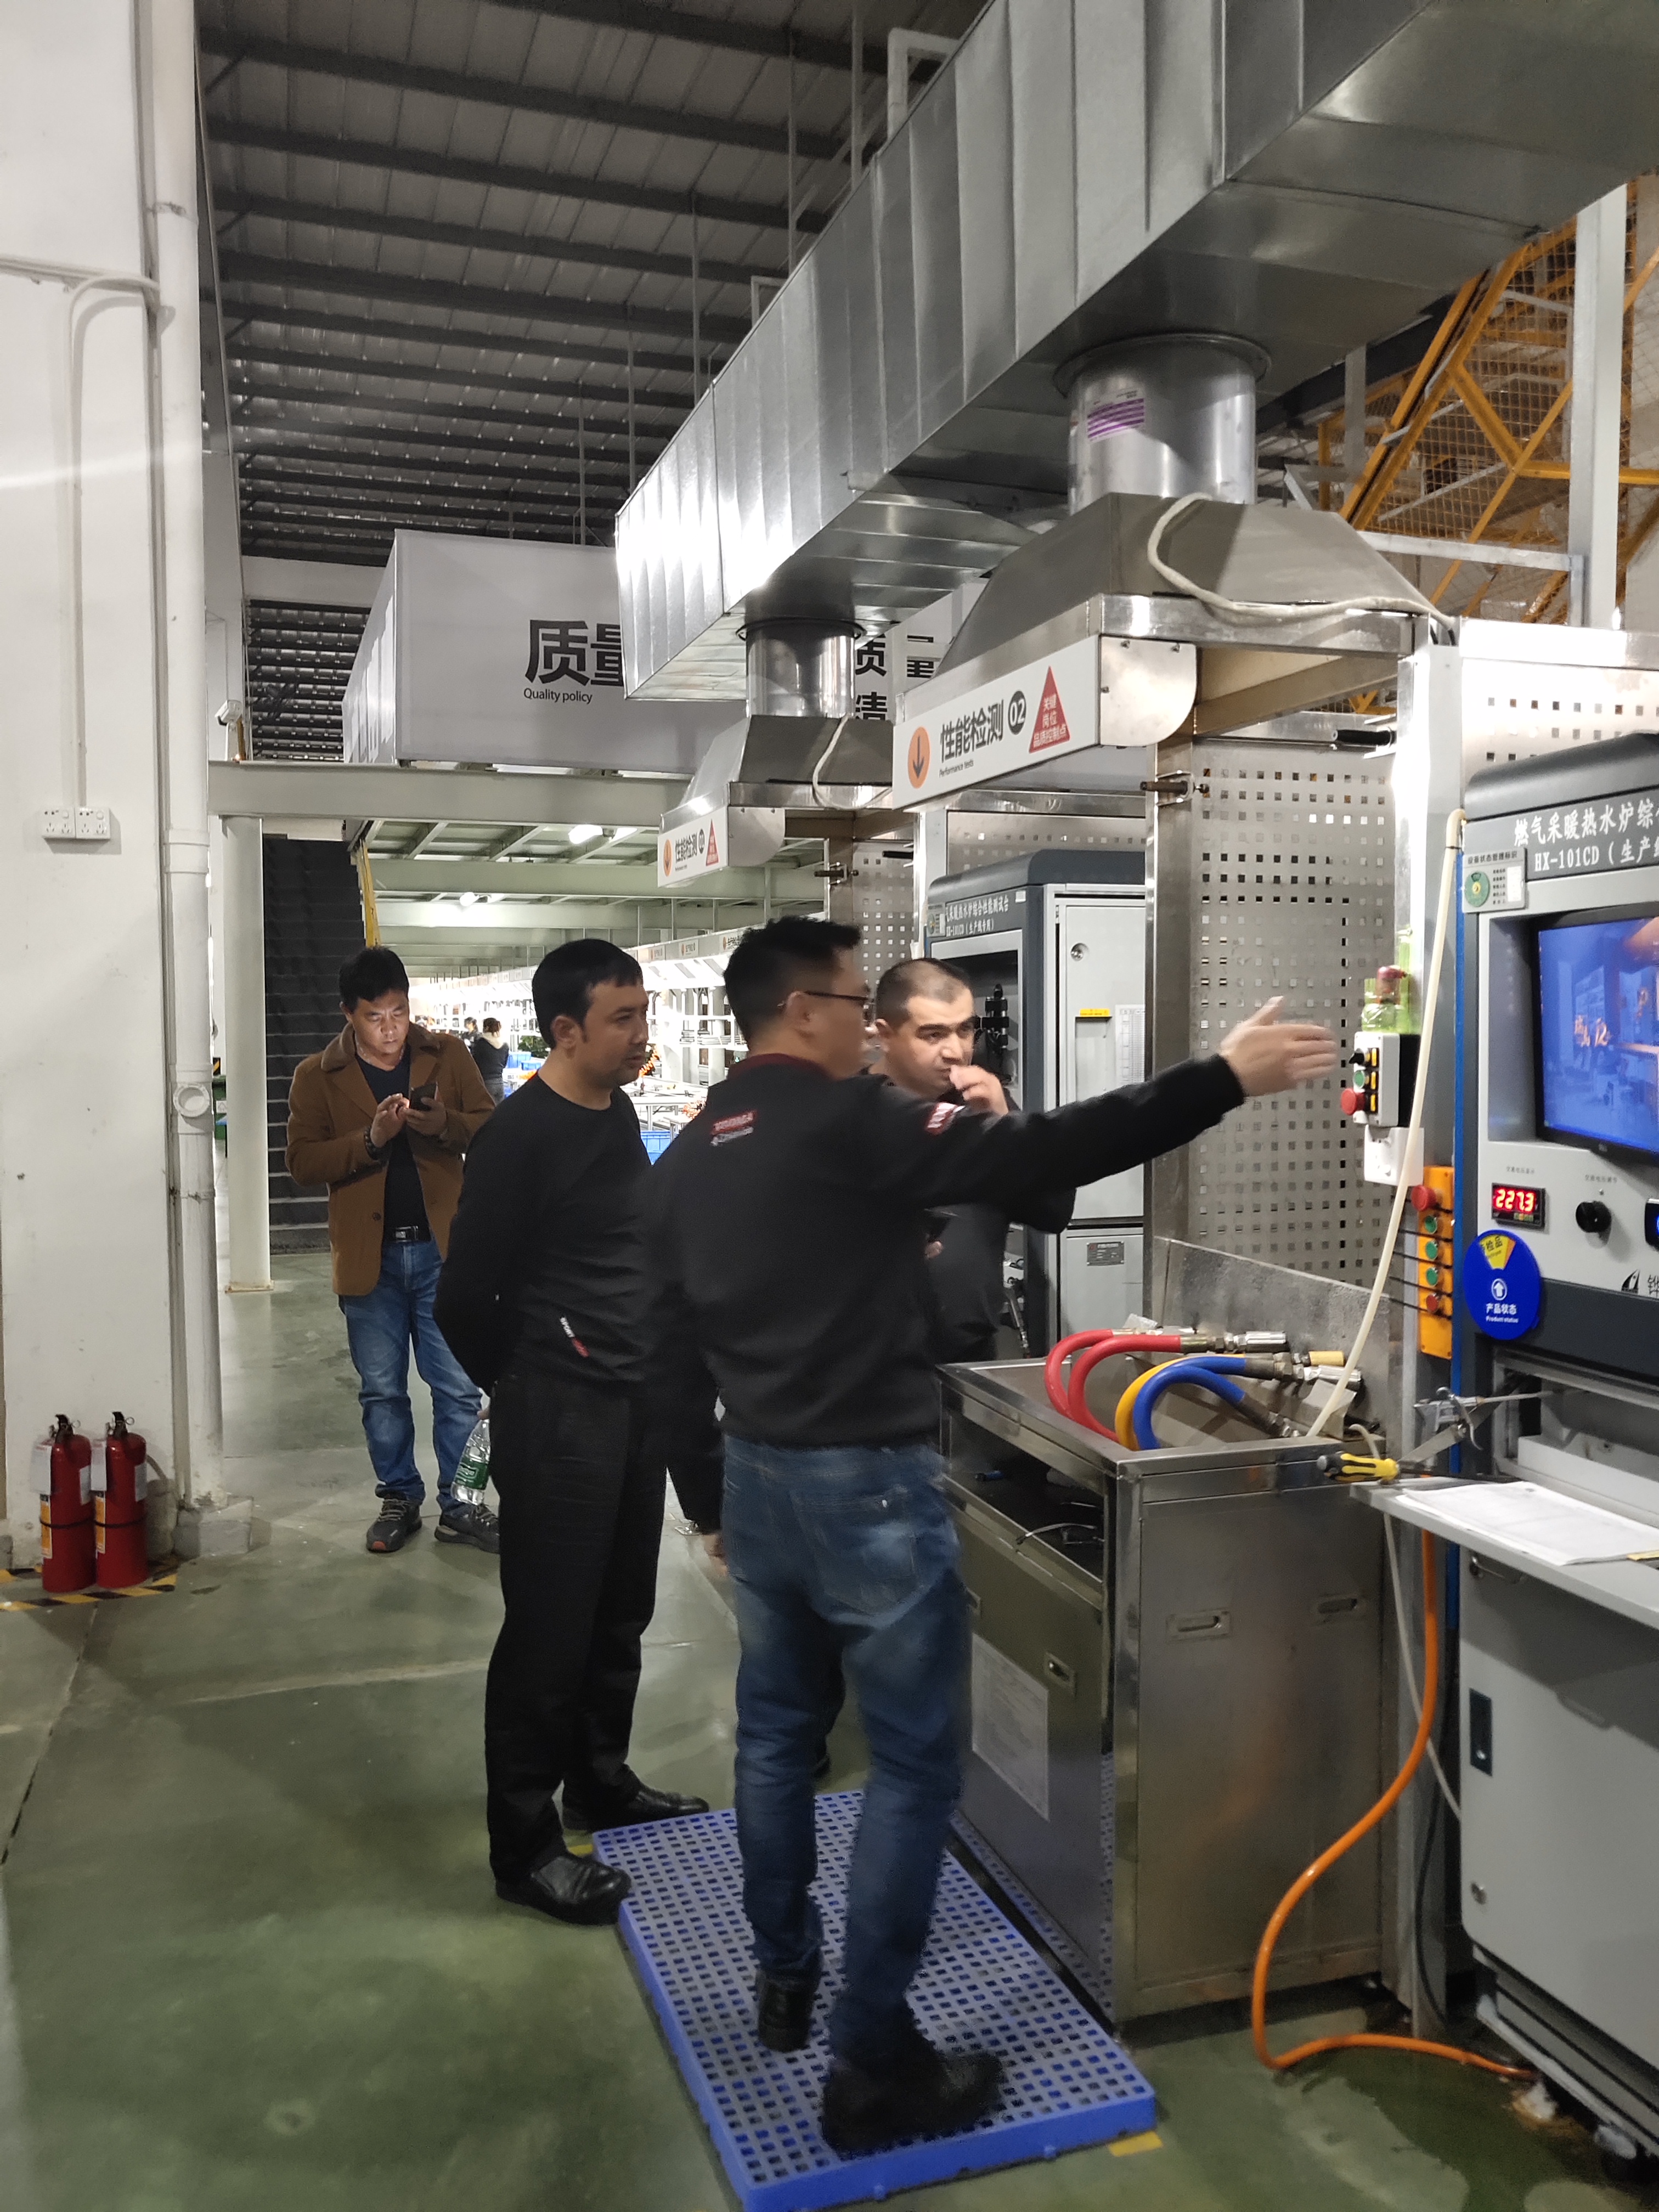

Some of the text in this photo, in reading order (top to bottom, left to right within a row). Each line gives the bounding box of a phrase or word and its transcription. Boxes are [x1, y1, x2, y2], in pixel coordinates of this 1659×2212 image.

[524, 619, 624, 687] 质量
[523, 687, 593, 704] Quality policy
[940, 698, 1026, 764] 性能检测 02
[1514, 798, 1659, 847] 燃气采暖热水炉综
[1534, 845, 1600, 872] HX-101CD
[1486, 1302, 1517, 1316] 产品状态
